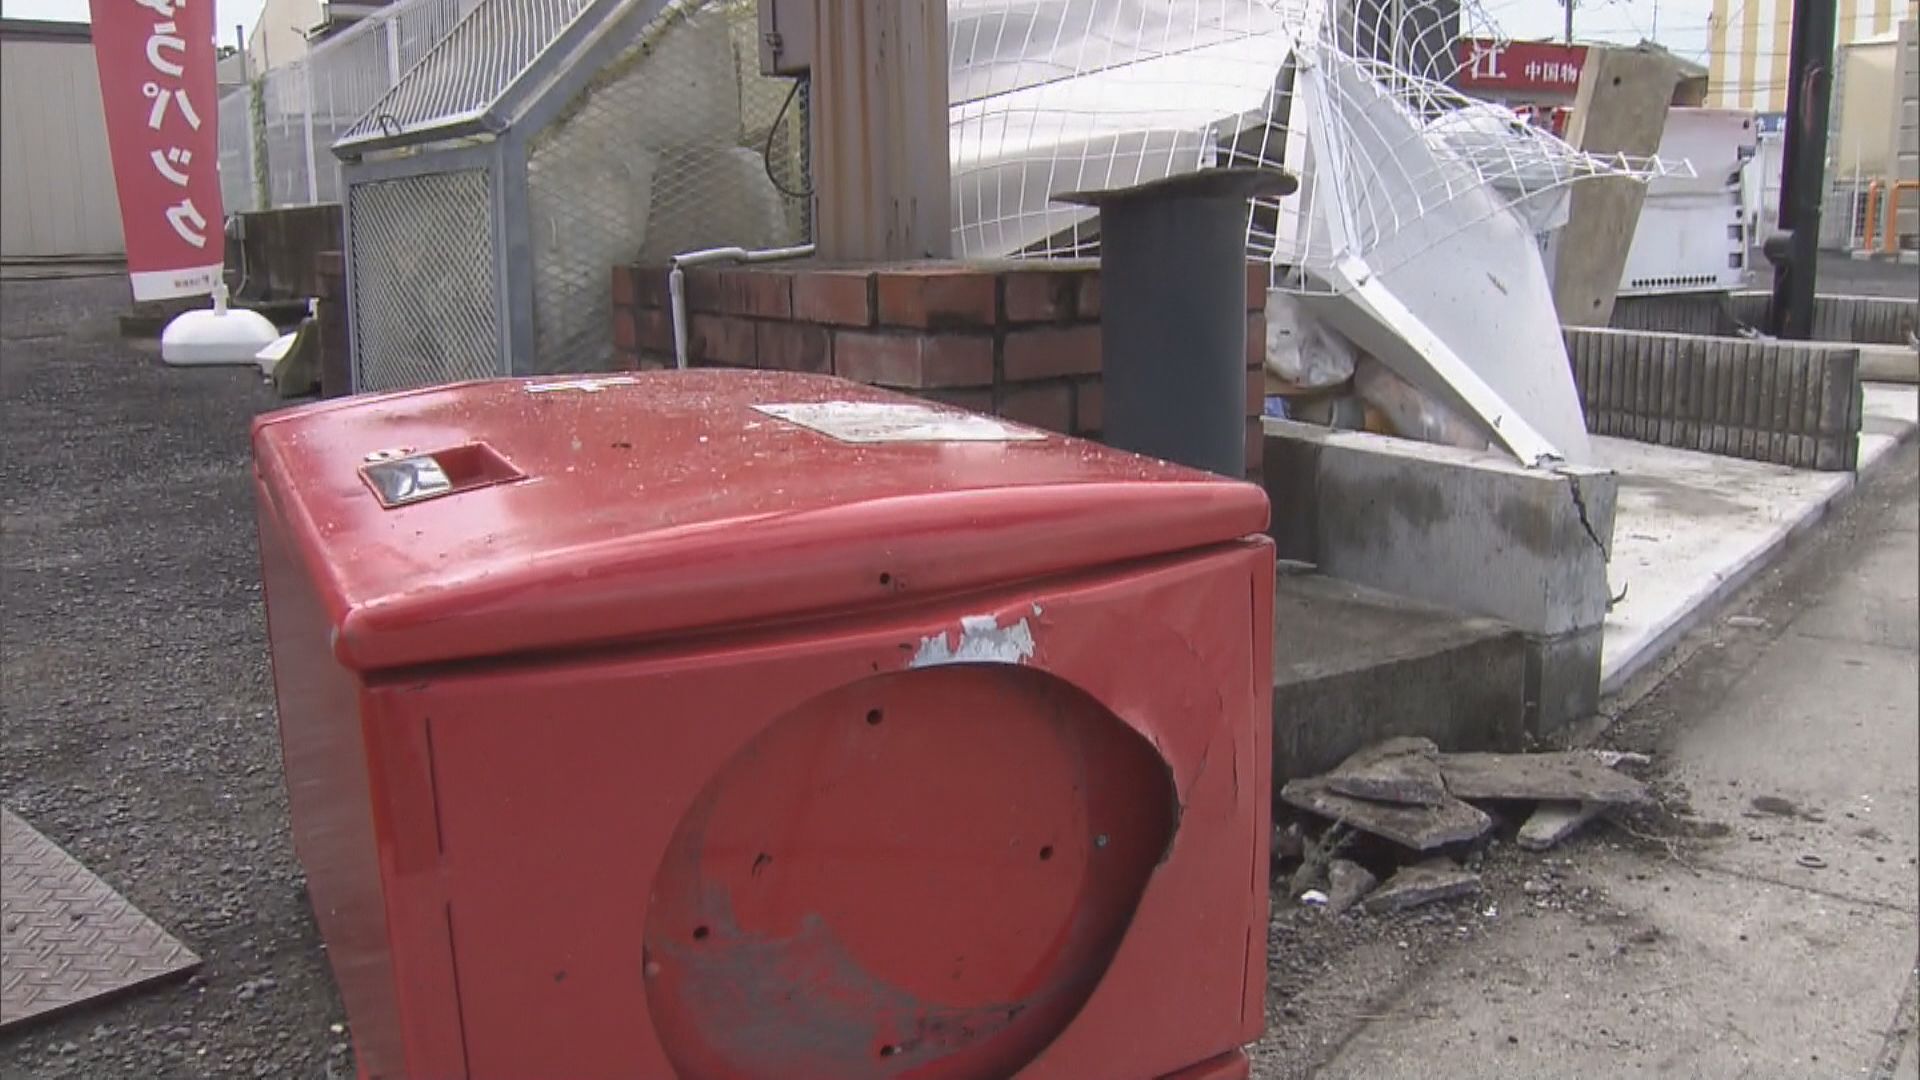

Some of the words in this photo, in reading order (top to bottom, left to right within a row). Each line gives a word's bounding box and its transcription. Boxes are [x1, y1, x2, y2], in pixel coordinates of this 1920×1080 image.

[1471, 48, 1507, 80] 江
[1525, 61, 1582, 83] 中国物
